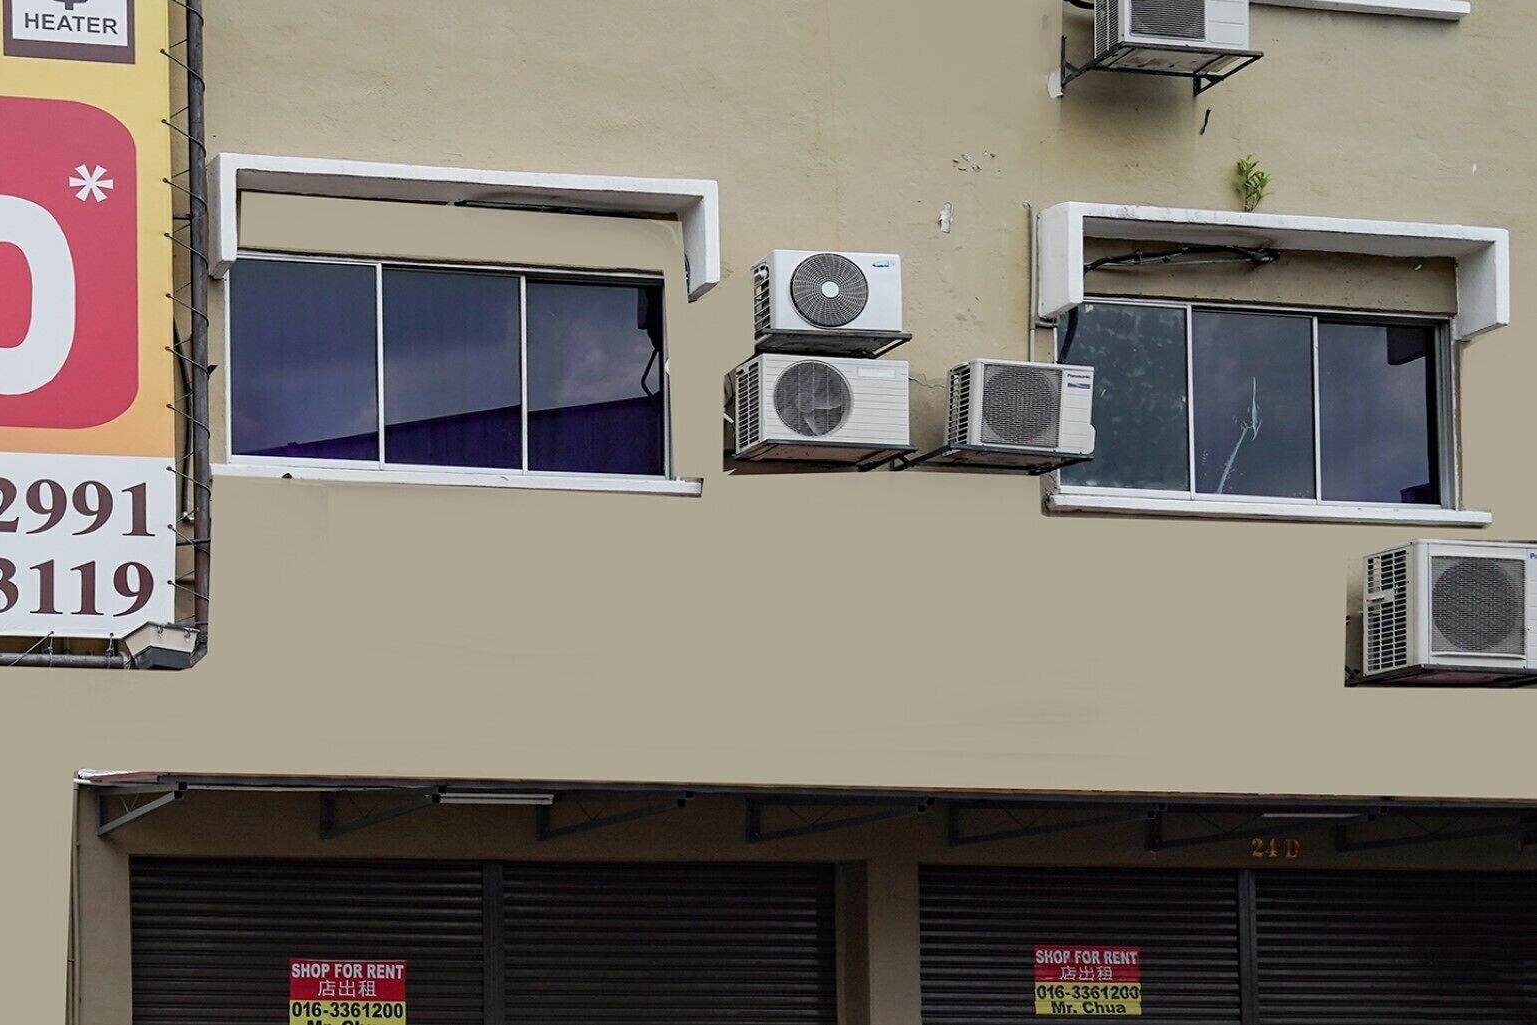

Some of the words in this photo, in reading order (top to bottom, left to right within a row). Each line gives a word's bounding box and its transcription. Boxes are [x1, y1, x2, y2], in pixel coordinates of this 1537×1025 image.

[24, 12, 119, 35] HEATER
[1035, 950, 1071, 965] SHOP
[1074, 951, 1100, 964] FOR
[1103, 951, 1139, 965] RENT
[291, 963, 330, 978] SHOP
[334, 963, 363, 978] FOR
[366, 964, 405, 979] RENT
[1059, 966, 1113, 982] 店出租
[317, 980, 377, 997] 店出租
[1036, 984, 1141, 1000] 016-3361200
[291, 1002, 404, 1018] 016-3361200
[1051, 1002, 1077, 1015] Mr.
[1082, 1001, 1127, 1015] Chua
